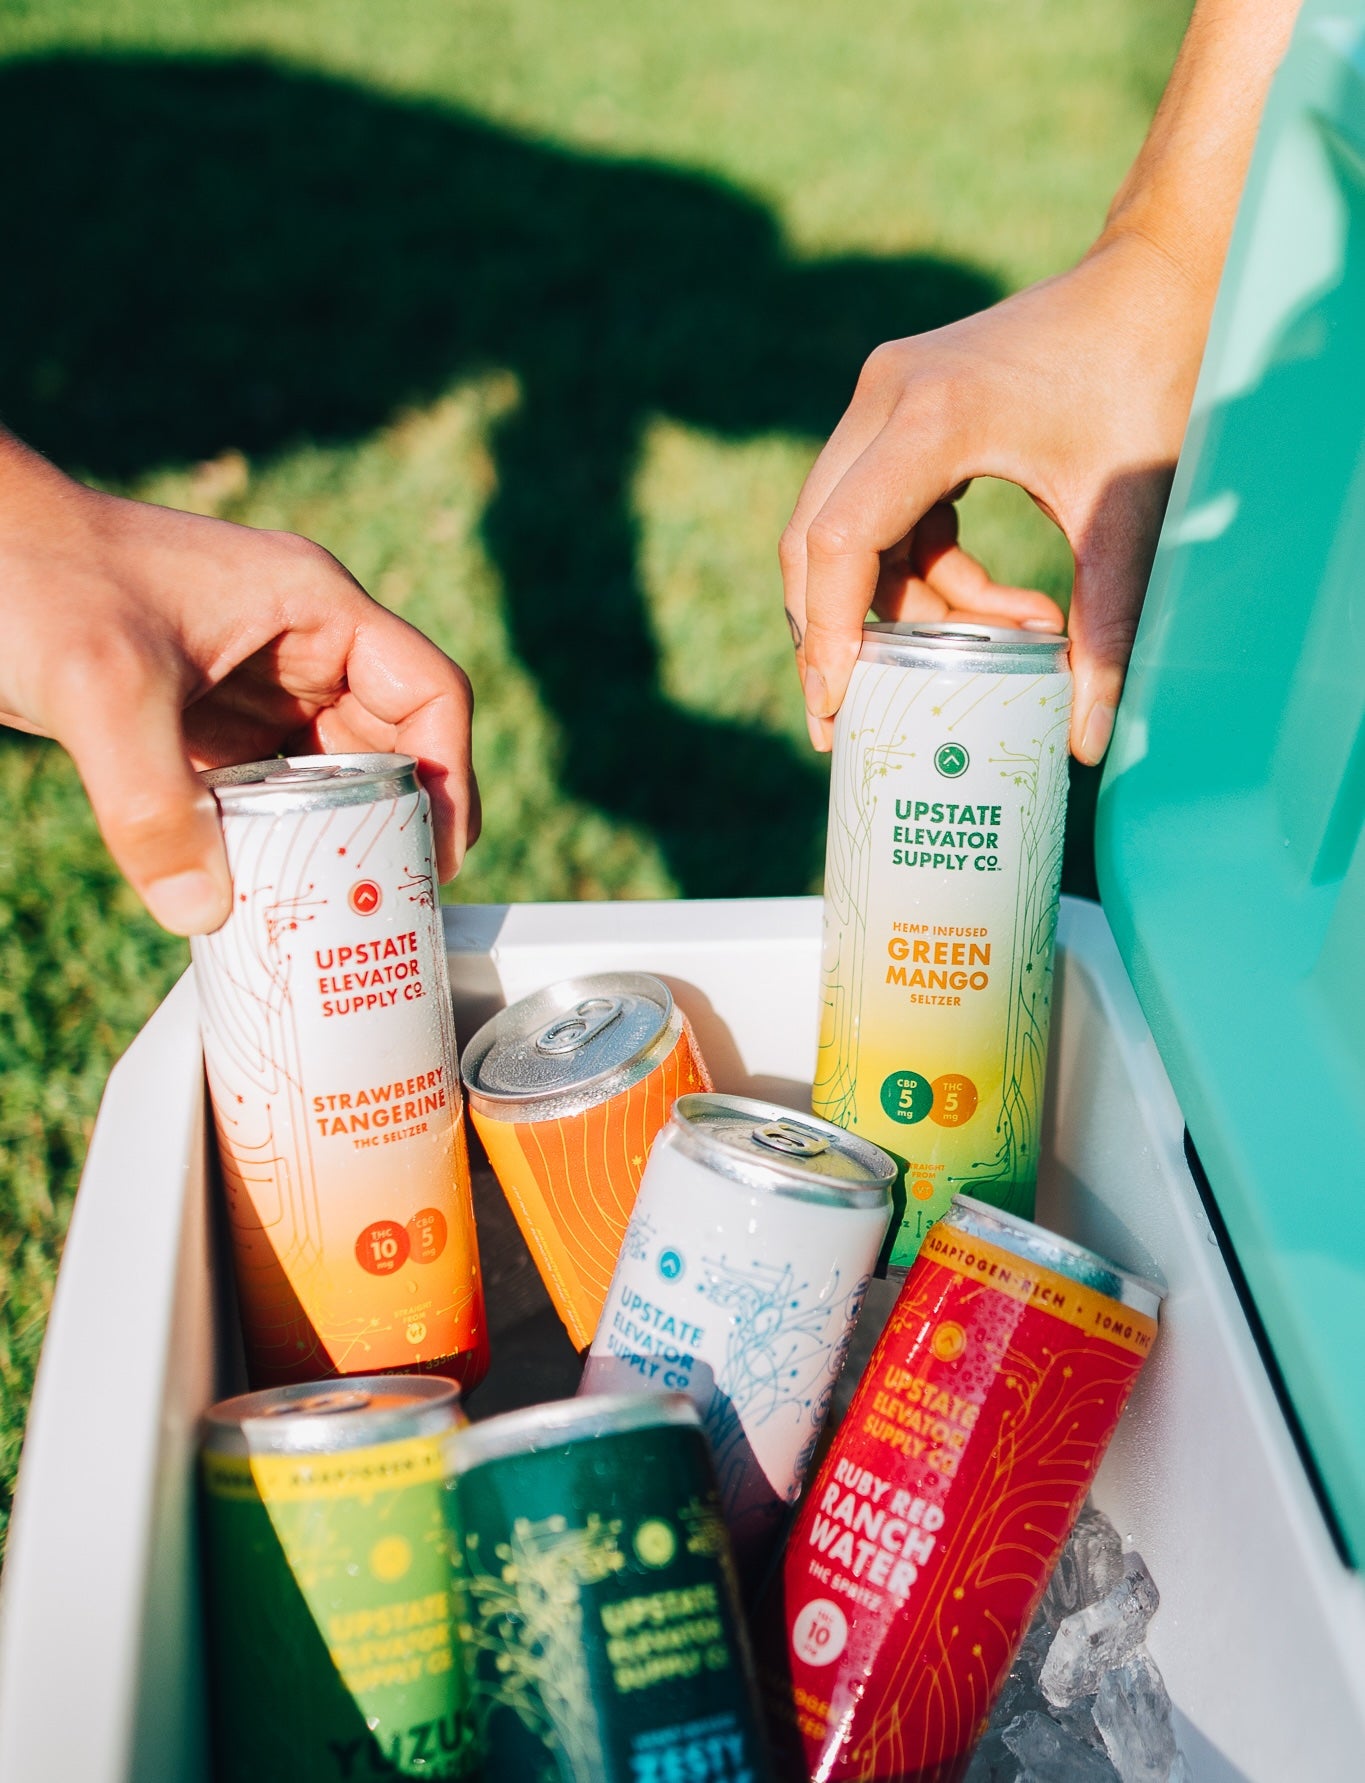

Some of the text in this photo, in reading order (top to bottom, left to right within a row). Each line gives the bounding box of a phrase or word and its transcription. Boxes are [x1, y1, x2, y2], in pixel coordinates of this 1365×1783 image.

[895, 799, 1002, 826] UPSTATE
[893, 826, 999, 849] ELEVATOR
[892, 849, 968, 871] SUPPLY
[893, 921, 988, 938] HEMP INFUSED
[314, 931, 418, 970] UPSTATE
[887, 937, 991, 966] GREEN
[318, 959, 420, 995] ELEVATOR
[885, 966, 989, 991] MANGO
[323, 987, 398, 1017] SUPPLY
[910, 994, 961, 1007] SELTZER
[313, 1066, 444, 1113] STRAWBERRY
[896, 1079, 918, 1089] CBD
[943, 1082, 964, 1092] THC
[898, 1090, 913, 1108] 5
[944, 1093, 959, 1111] 5
[317, 1089, 446, 1137] TANGERINE
[897, 1109, 913, 1120] mg
[943, 1113, 959, 1122] mg
[354, 1122, 428, 1150] THC SELTZER
[912, 1171, 936, 1179] FROM
[371, 1229, 392, 1240] THC
[421, 1227, 434, 1247] 5
[370, 1239, 398, 1261] 10
[620, 1285, 705, 1348] UPSTATE
[1095, 1312, 1133, 1339] 10MG
[613, 1311, 695, 1372] ELEVATOR
[607, 1334, 658, 1378] SUPPLY
[884, 1365, 980, 1430] UPSTATE
[872, 1391, 965, 1447] ELEVATOR
[863, 1414, 927, 1459] SUPPLY
[834, 1457, 945, 1532] RUBY RED
[820, 1482, 936, 1567] RANCH
[809, 1513, 918, 1600] WATER
[808, 1621, 831, 1646] 10
[329, 1710, 465, 1780] YUZU
